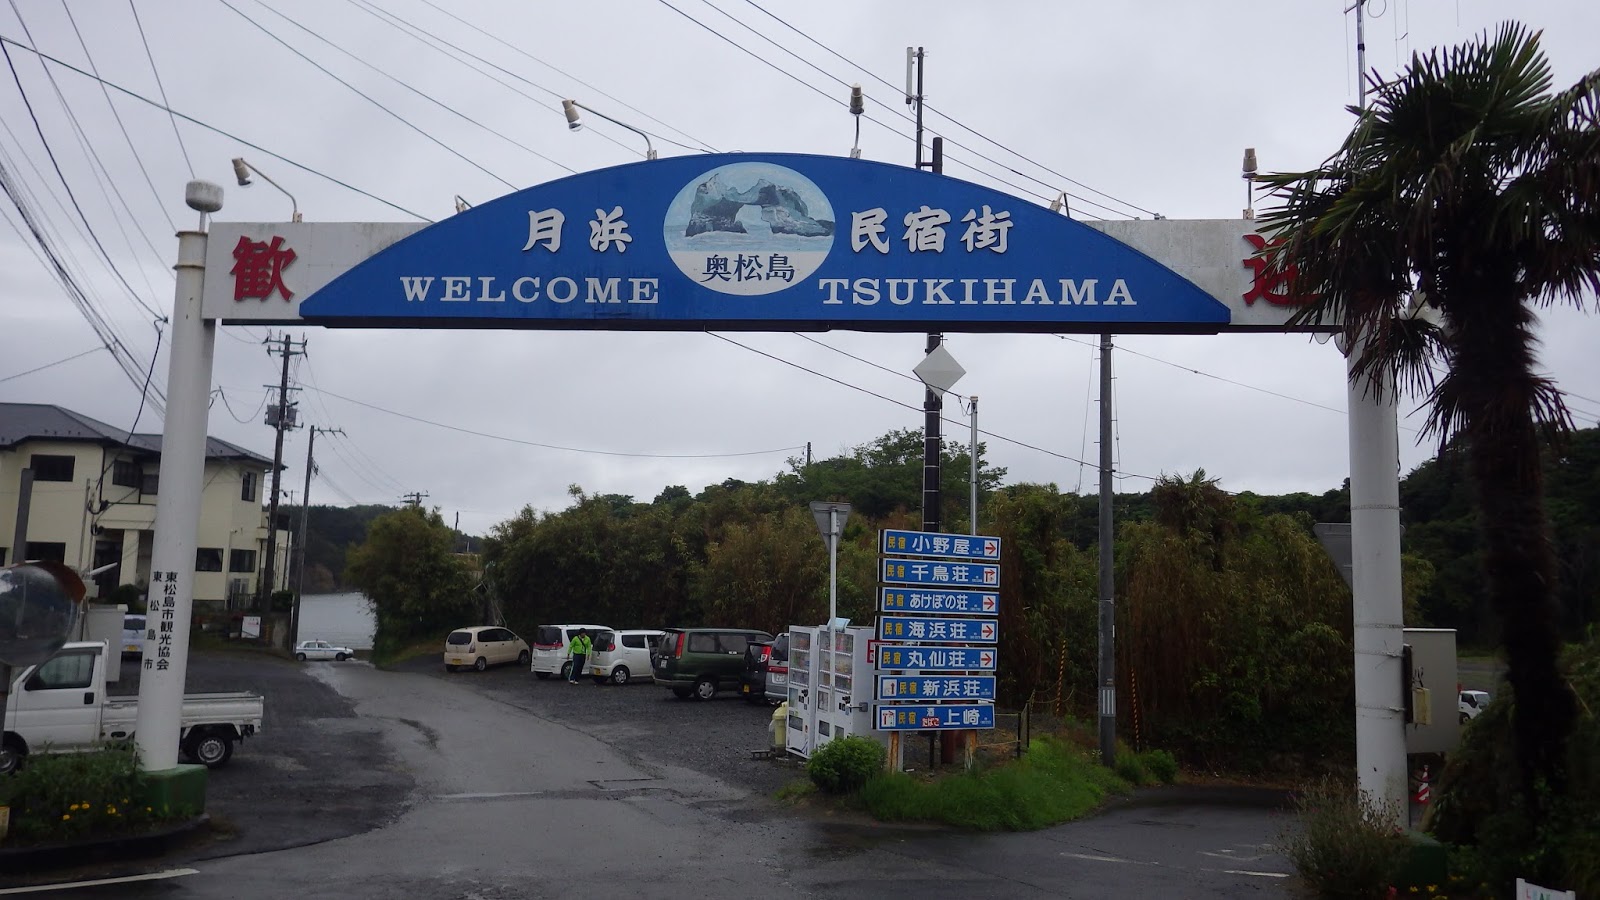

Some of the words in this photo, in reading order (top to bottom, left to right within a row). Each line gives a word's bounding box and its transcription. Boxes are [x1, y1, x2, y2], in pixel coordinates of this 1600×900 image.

[522, 206, 633, 253] 月浜
[850, 205, 1013, 254] 民宿街
[229, 235, 298, 302] 歓
[700, 253, 796, 283] 奥松島
[399, 276, 660, 305] WELCOME
[818, 277, 1137, 306] TSUKIHAMA
[887, 535, 906, 549] 民宿
[911, 535, 970, 555] 小野屋
[886, 564, 905, 578] 民宿
[911, 564, 970, 582] 千鳥荘
[886, 593, 904, 607] 民宿
[909, 593, 968, 611] あけぼの荘
[143, 571, 164, 671] 東松島市
[156, 571, 179, 671] 東松島市観光協会
[884, 622, 903, 635] 民宿
[908, 621, 967, 639] 海浜荘
[882, 651, 901, 665] 民宿
[906, 650, 966, 668] 丸仙荘
[899, 681, 917, 694] 民宿
[922, 679, 981, 697] 新浜荘
[897, 711, 916, 725] 民宿
[943, 708, 980, 726] 上崎
